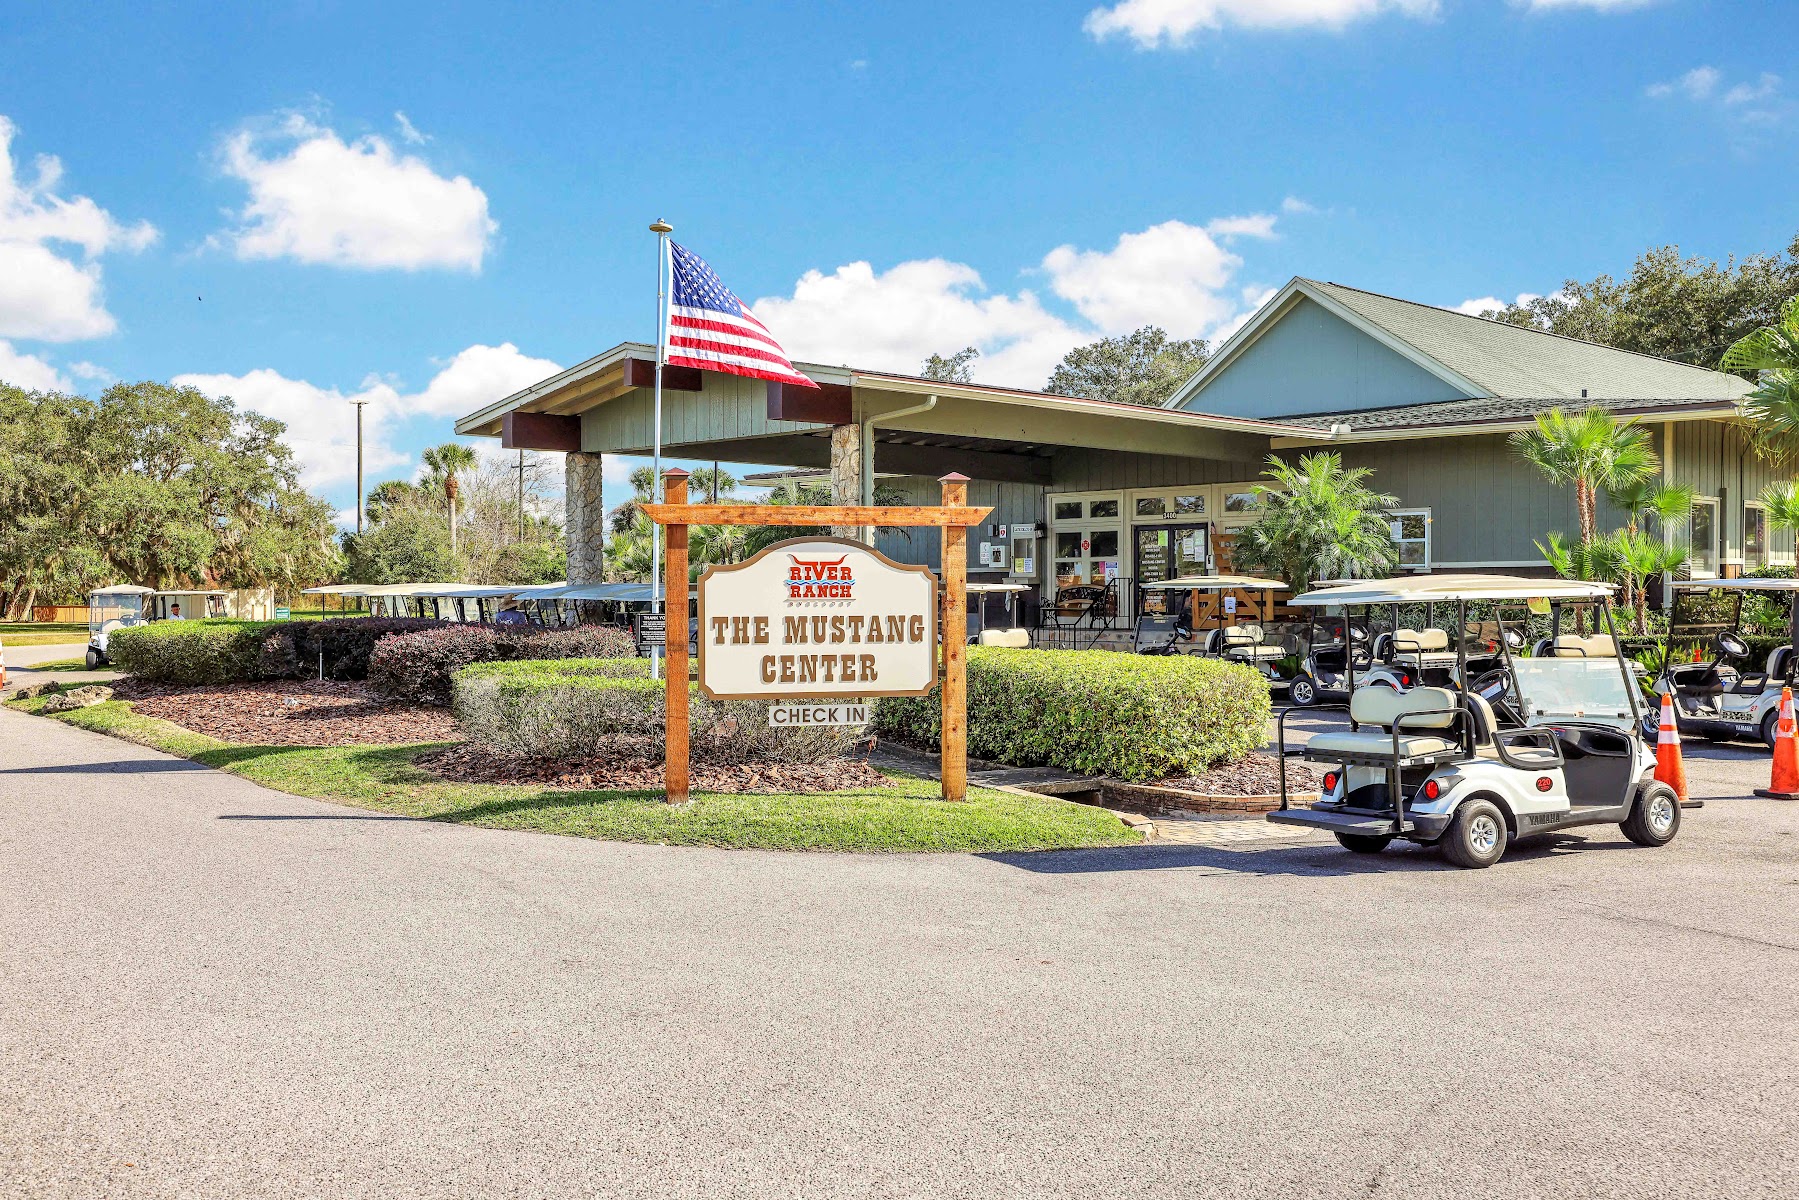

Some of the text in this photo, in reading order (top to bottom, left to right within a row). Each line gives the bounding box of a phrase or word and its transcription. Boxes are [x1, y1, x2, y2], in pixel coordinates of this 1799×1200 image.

[789, 561, 852, 580] RIVER
[790, 585, 852, 598] RANCH
[711, 615, 925, 645] THE MUSTANG
[761, 654, 878, 683] CENTER
[773, 707, 865, 723] CHECK IN
[1538, 778, 1551, 786] 220
[1529, 812, 1560, 826] YAMAHA
